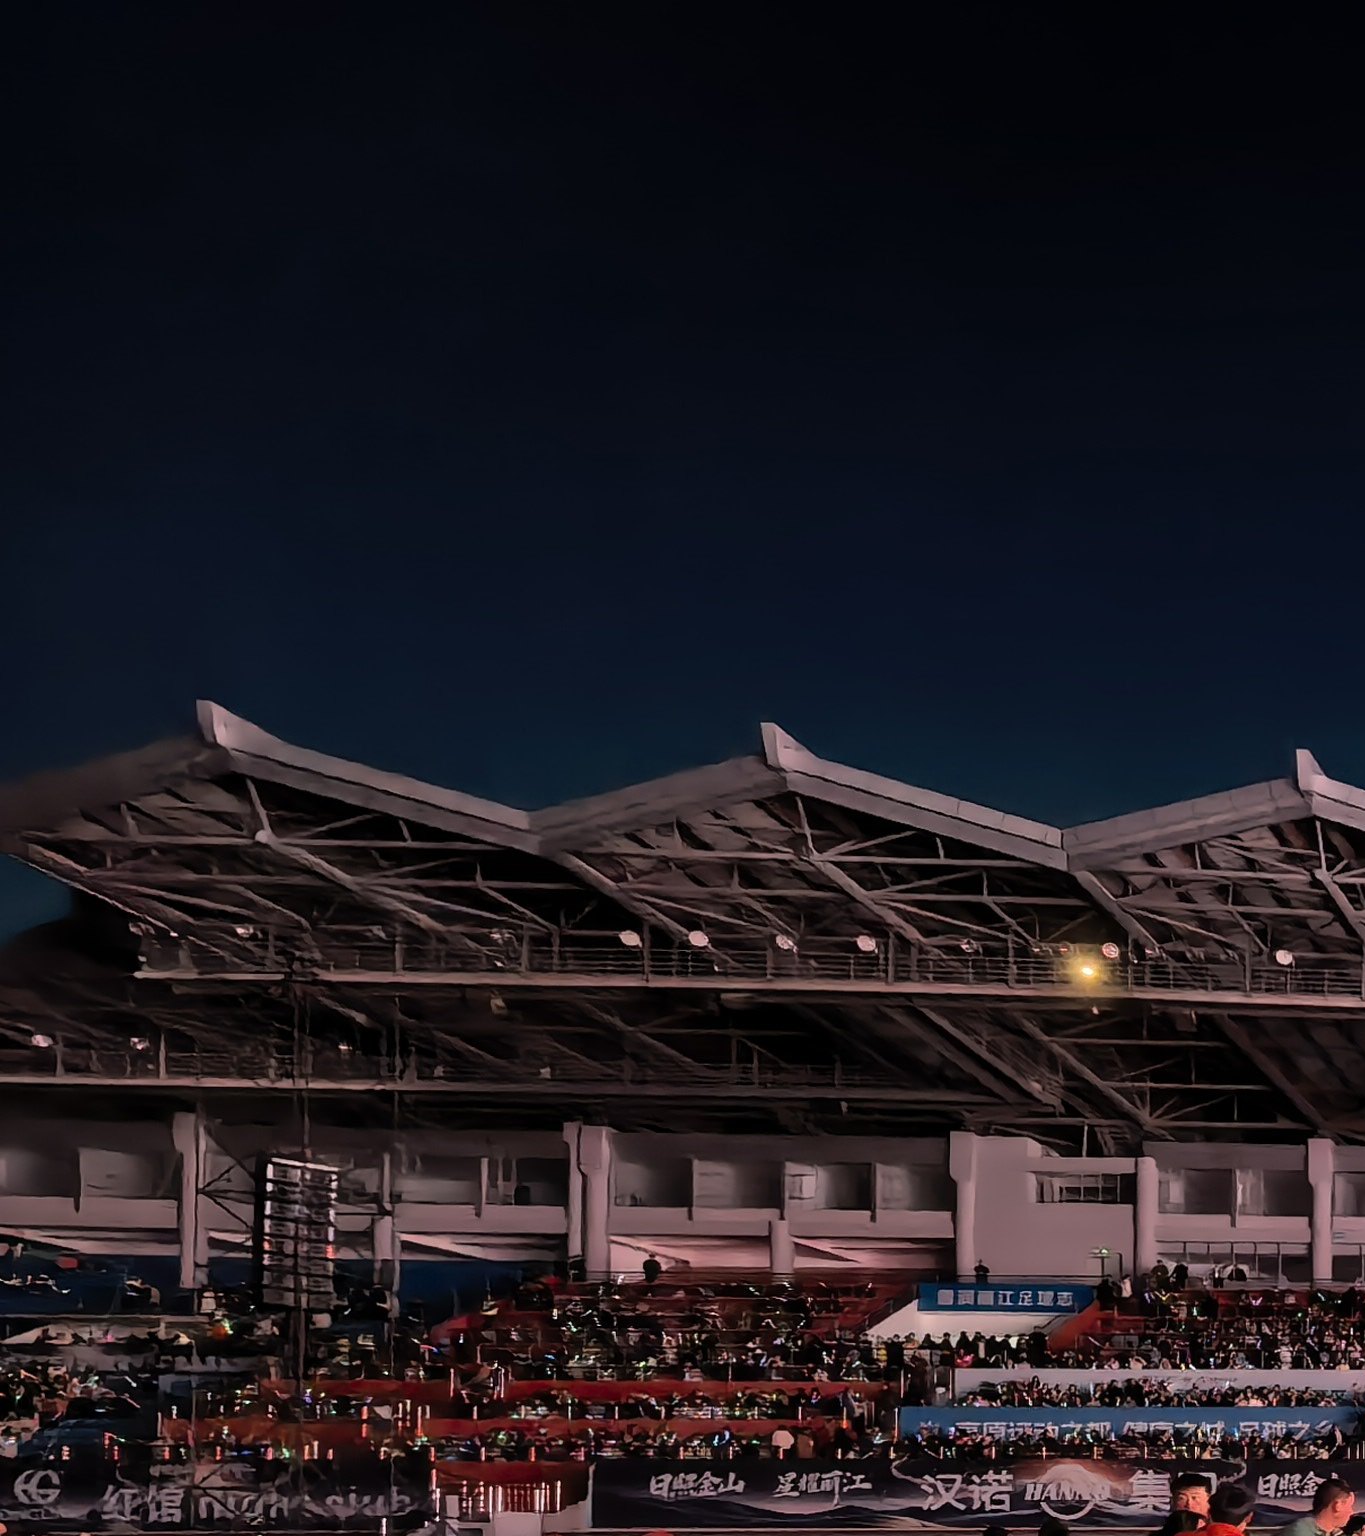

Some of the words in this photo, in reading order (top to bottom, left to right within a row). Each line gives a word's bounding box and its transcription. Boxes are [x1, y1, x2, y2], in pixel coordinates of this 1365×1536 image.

[648, 1471, 745, 1498] 日照金山
[919, 1470, 1014, 1512] 汉诺
[1257, 1470, 1339, 1498] 日照金
